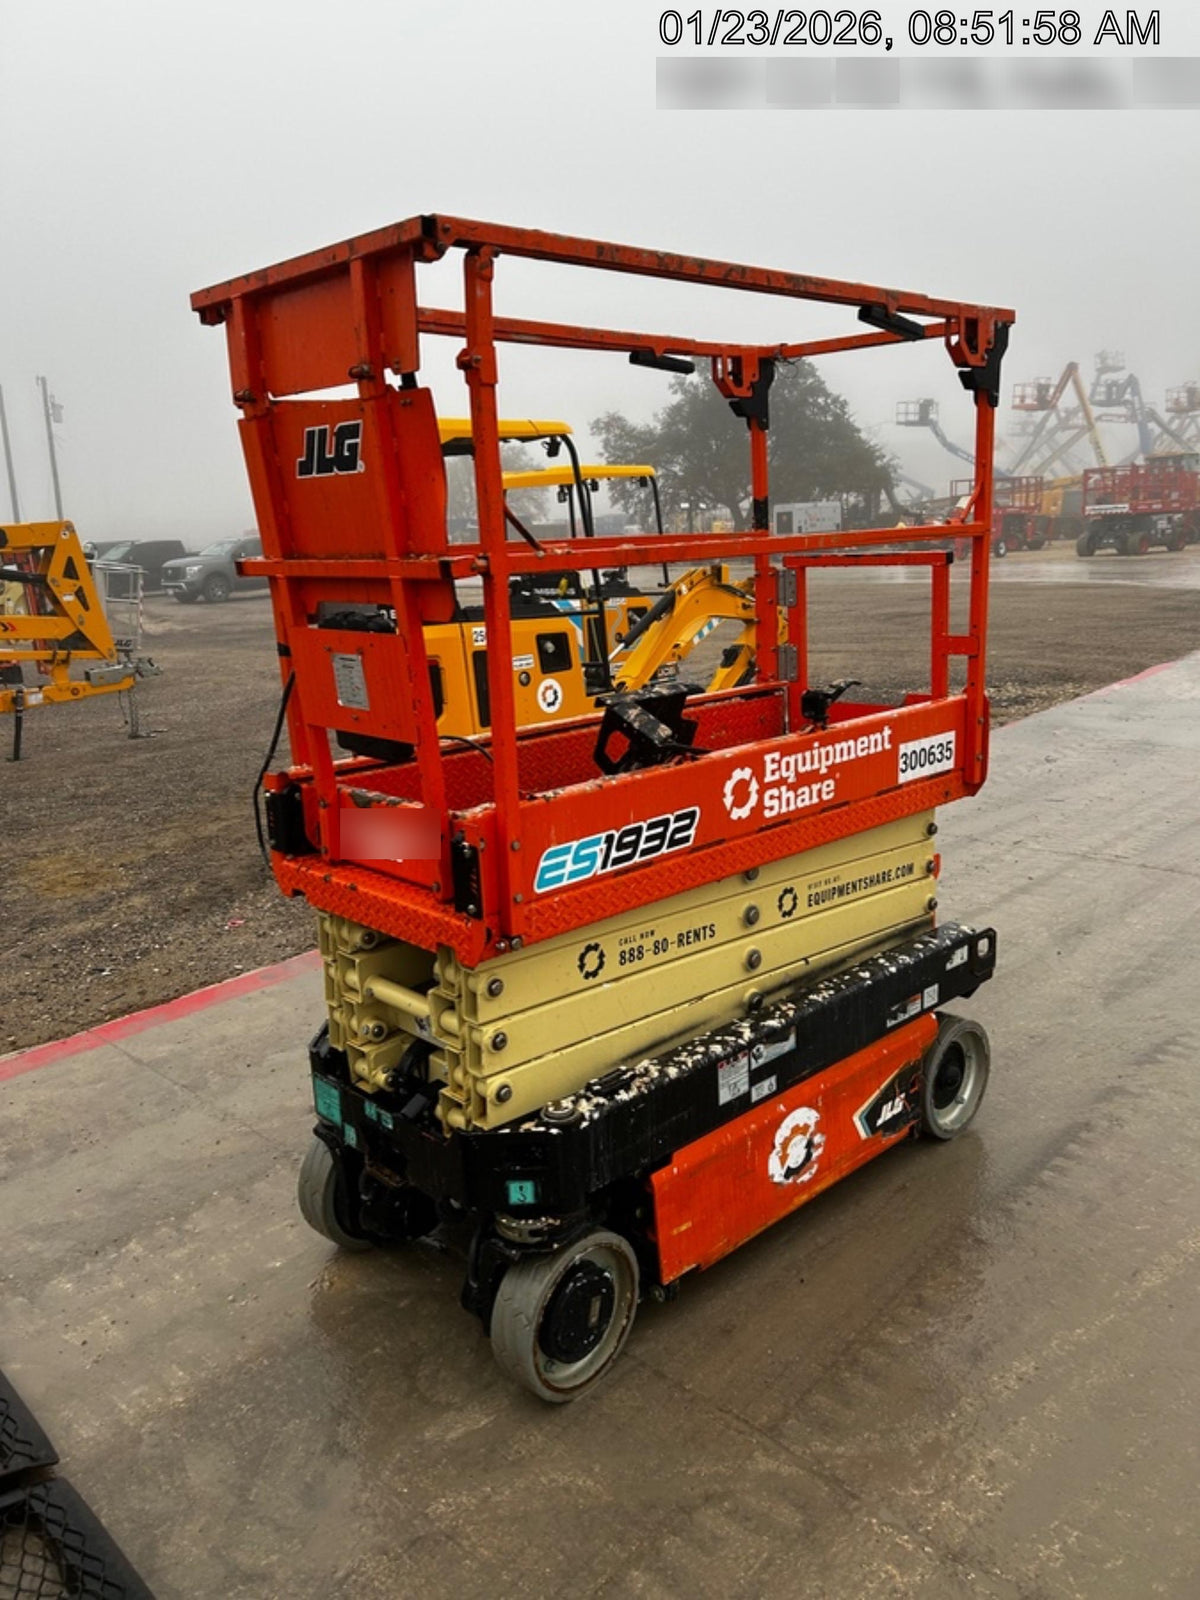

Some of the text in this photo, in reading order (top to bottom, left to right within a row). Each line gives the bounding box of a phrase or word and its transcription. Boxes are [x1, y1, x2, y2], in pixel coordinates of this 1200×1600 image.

[297, 420, 363, 478] JLG
[763, 725, 892, 783] Equipment
[900, 741, 953, 774] 300635
[763, 778, 835, 819] Share
[535, 807, 699, 892] ES1932
[808, 862, 915, 908] EQUIPMENTSHARE.COM
[619, 923, 716, 966] 888-80-RENTS
